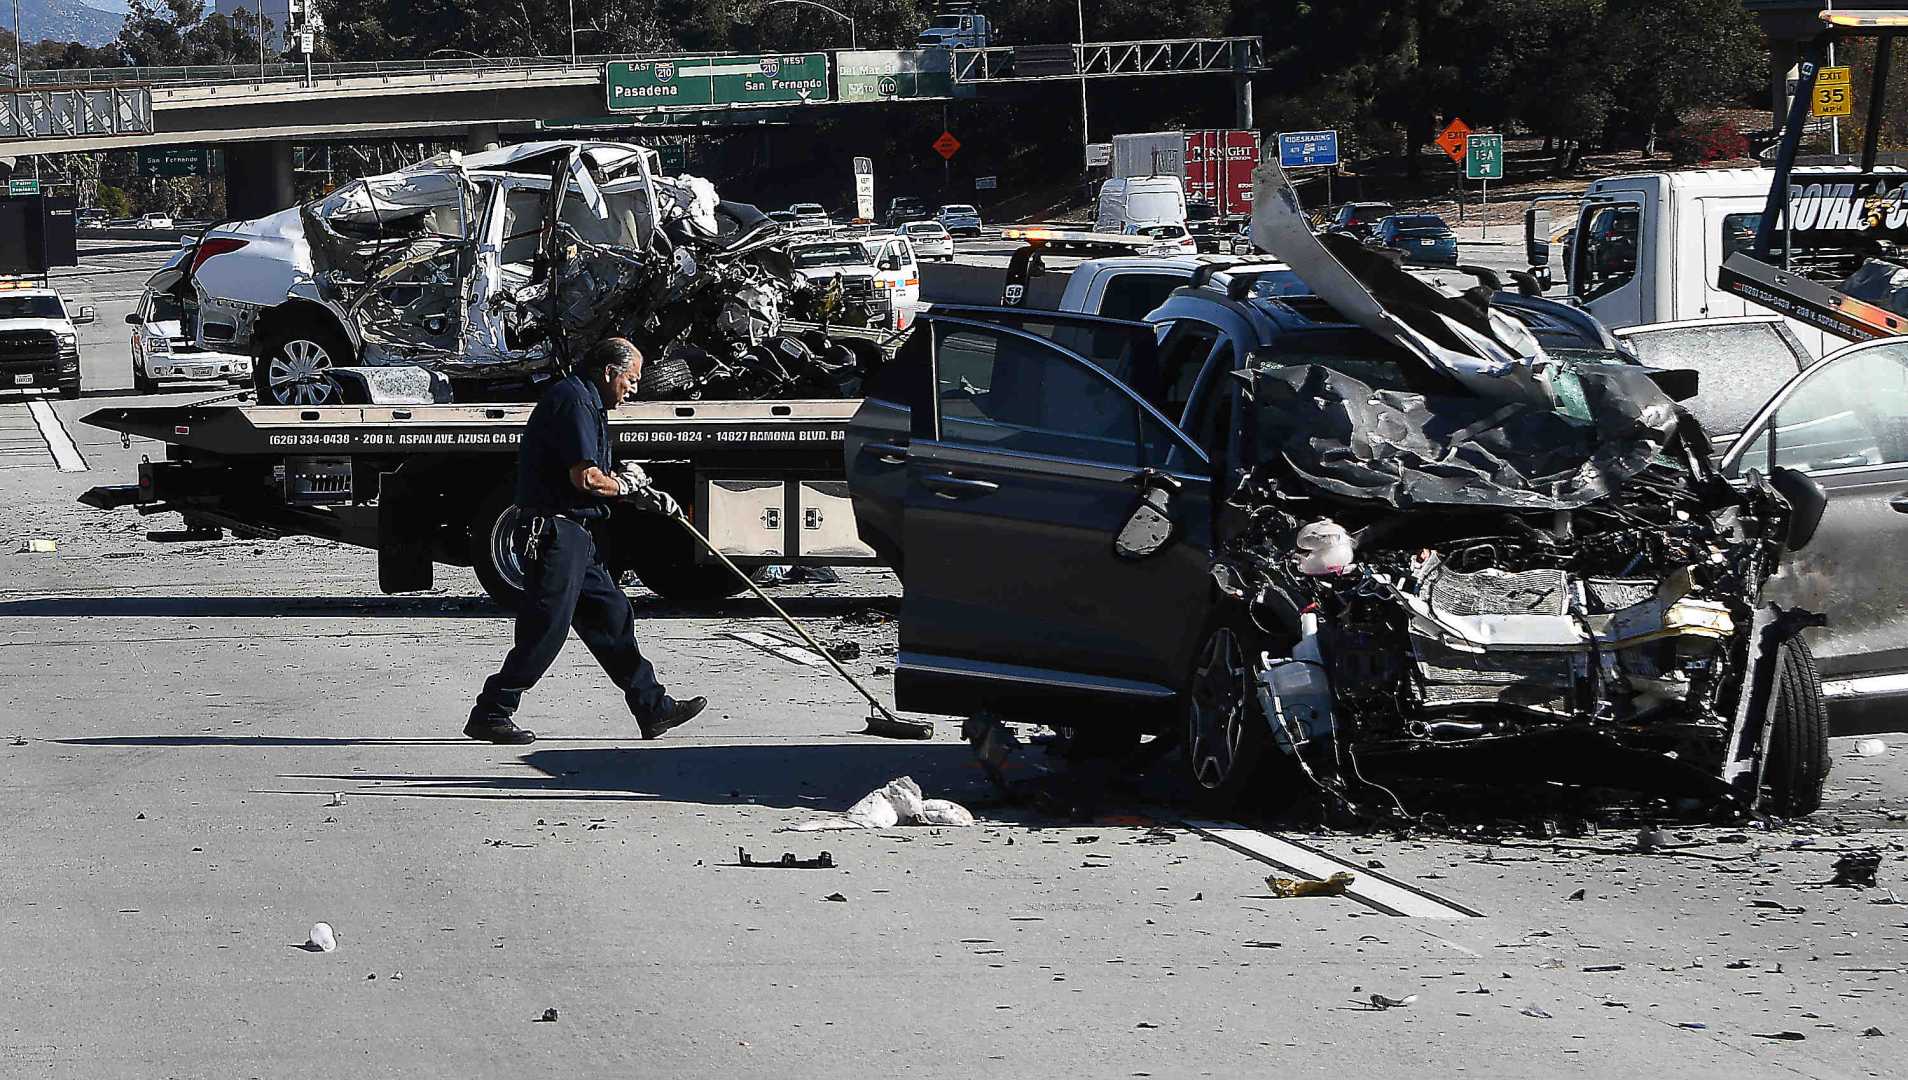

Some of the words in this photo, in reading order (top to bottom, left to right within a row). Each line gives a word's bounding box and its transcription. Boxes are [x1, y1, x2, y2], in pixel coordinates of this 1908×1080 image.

[628, 63, 650, 71] EAST
[657, 69, 672, 78] 210
[763, 64, 777, 73] 210
[783, 57, 805, 65] WEST
[1820, 72, 1842, 80] EXIT
[745, 81, 765, 91] San
[772, 79, 822, 89] Fernando
[881, 84, 895, 92] 110
[615, 85, 678, 98] Pasadena
[1820, 89, 1844, 104] 35
[1285, 135, 1331, 143] RIDESHARING
[1447, 131, 1467, 140] EXIT
[1472, 138, 1498, 147] EXIT
[1209, 146, 1253, 157] KNIGHT
[1775, 183, 1871, 231] ROYAL
[269, 434, 298, 445] (626)
[300, 433, 350, 445] 334-0438
[362, 433, 384, 444] 208
[385, 433, 395, 444] N.
[399, 433, 433, 444] ASPAN
[457, 433, 491, 444] AZUSA
[492, 433, 507, 444] CA
[508, 432, 524, 444] 91
[619, 431, 649, 442] (626)
[650, 431, 702, 442] 960-1824
[716, 431, 748, 441] 14827
[749, 431, 796, 441] RAMONA
[798, 430, 829, 441] BLVD.
